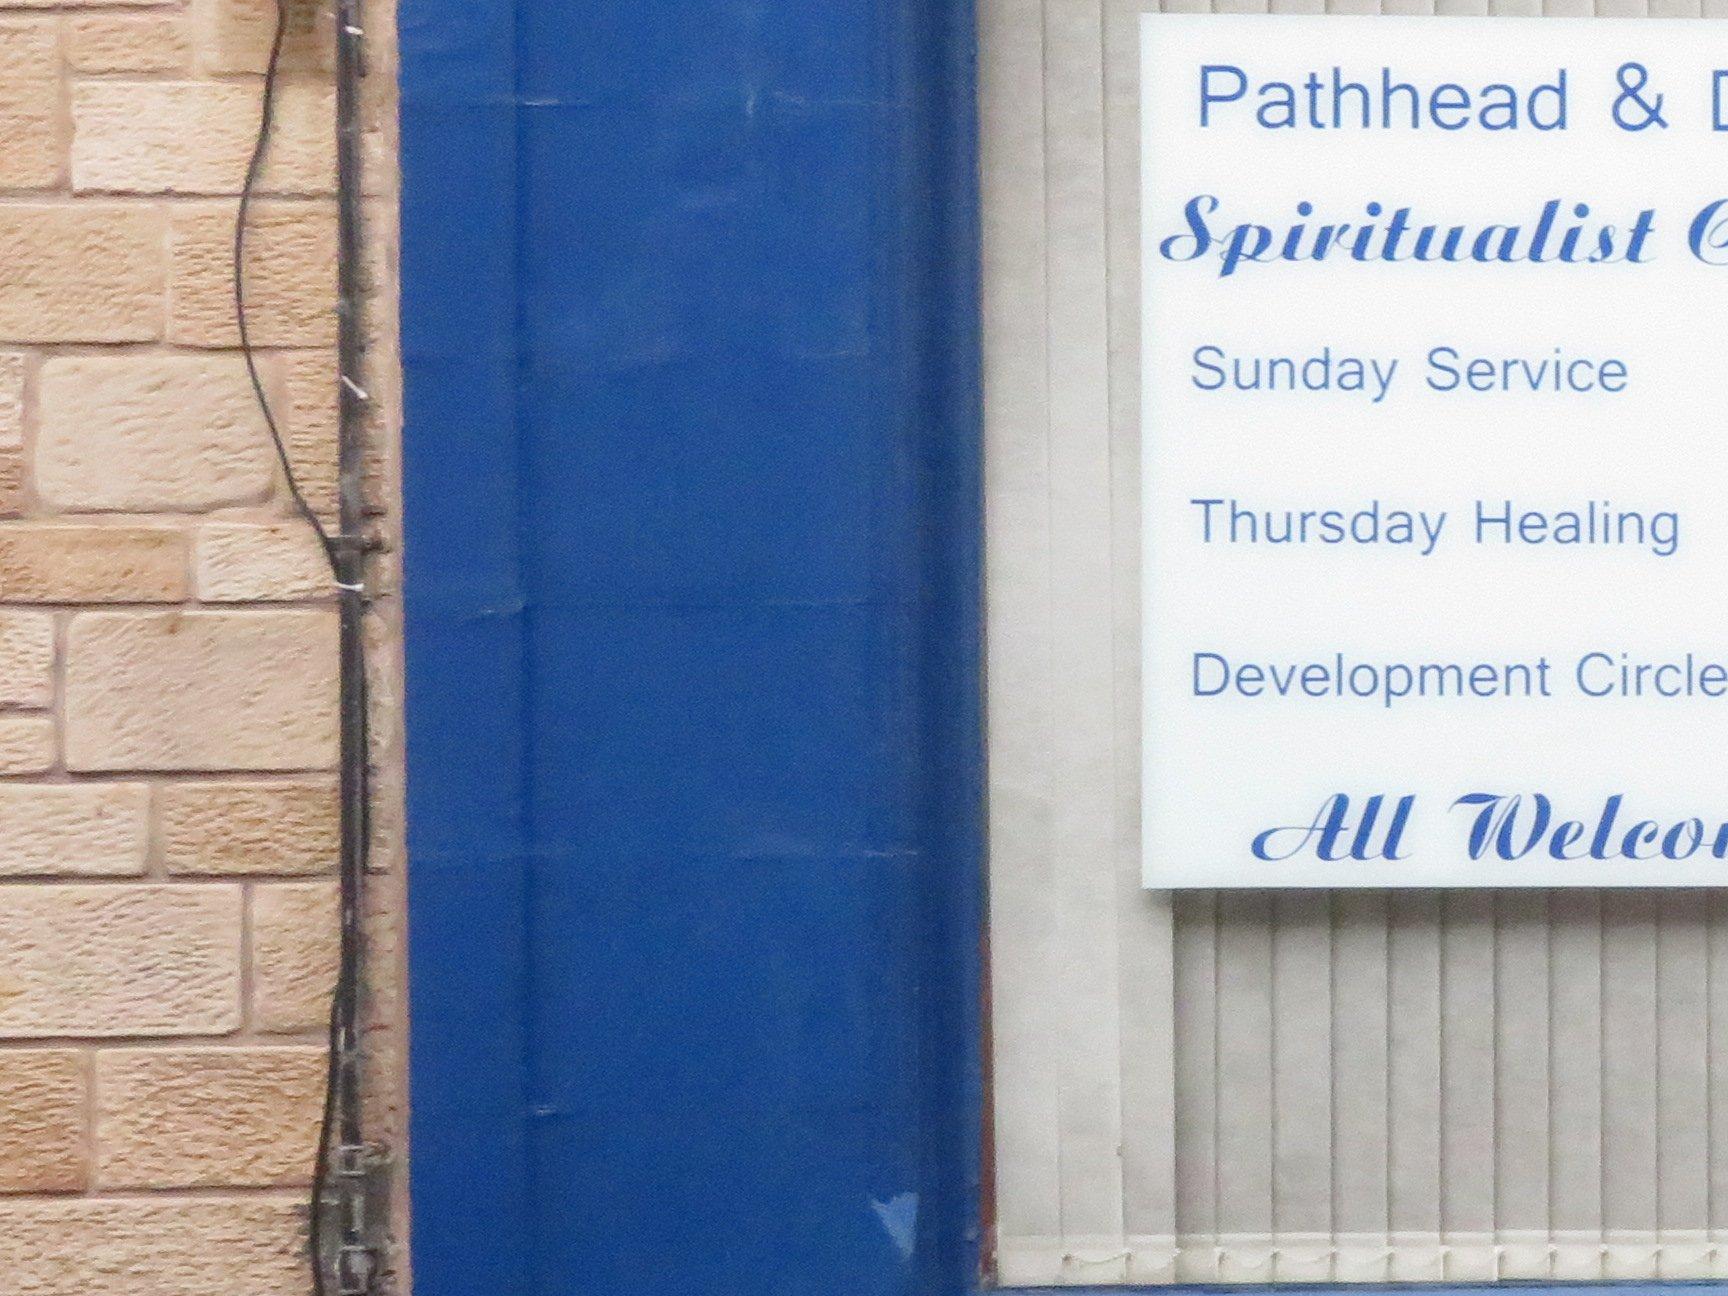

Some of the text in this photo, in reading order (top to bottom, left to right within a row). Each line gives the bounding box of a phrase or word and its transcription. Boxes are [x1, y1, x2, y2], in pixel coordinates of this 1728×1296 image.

[1197, 62, 1571, 134] Pathhead
[1609, 59, 1671, 135] &
[1157, 193, 1658, 280] Spiritualist
[1190, 343, 1400, 406] Sunday
[1425, 343, 1630, 396] Service
[1188, 496, 1449, 558] Thursday
[1473, 499, 1682, 559] Healing
[1190, 649, 1552, 710] Development
[1247, 789, 1419, 865] All
